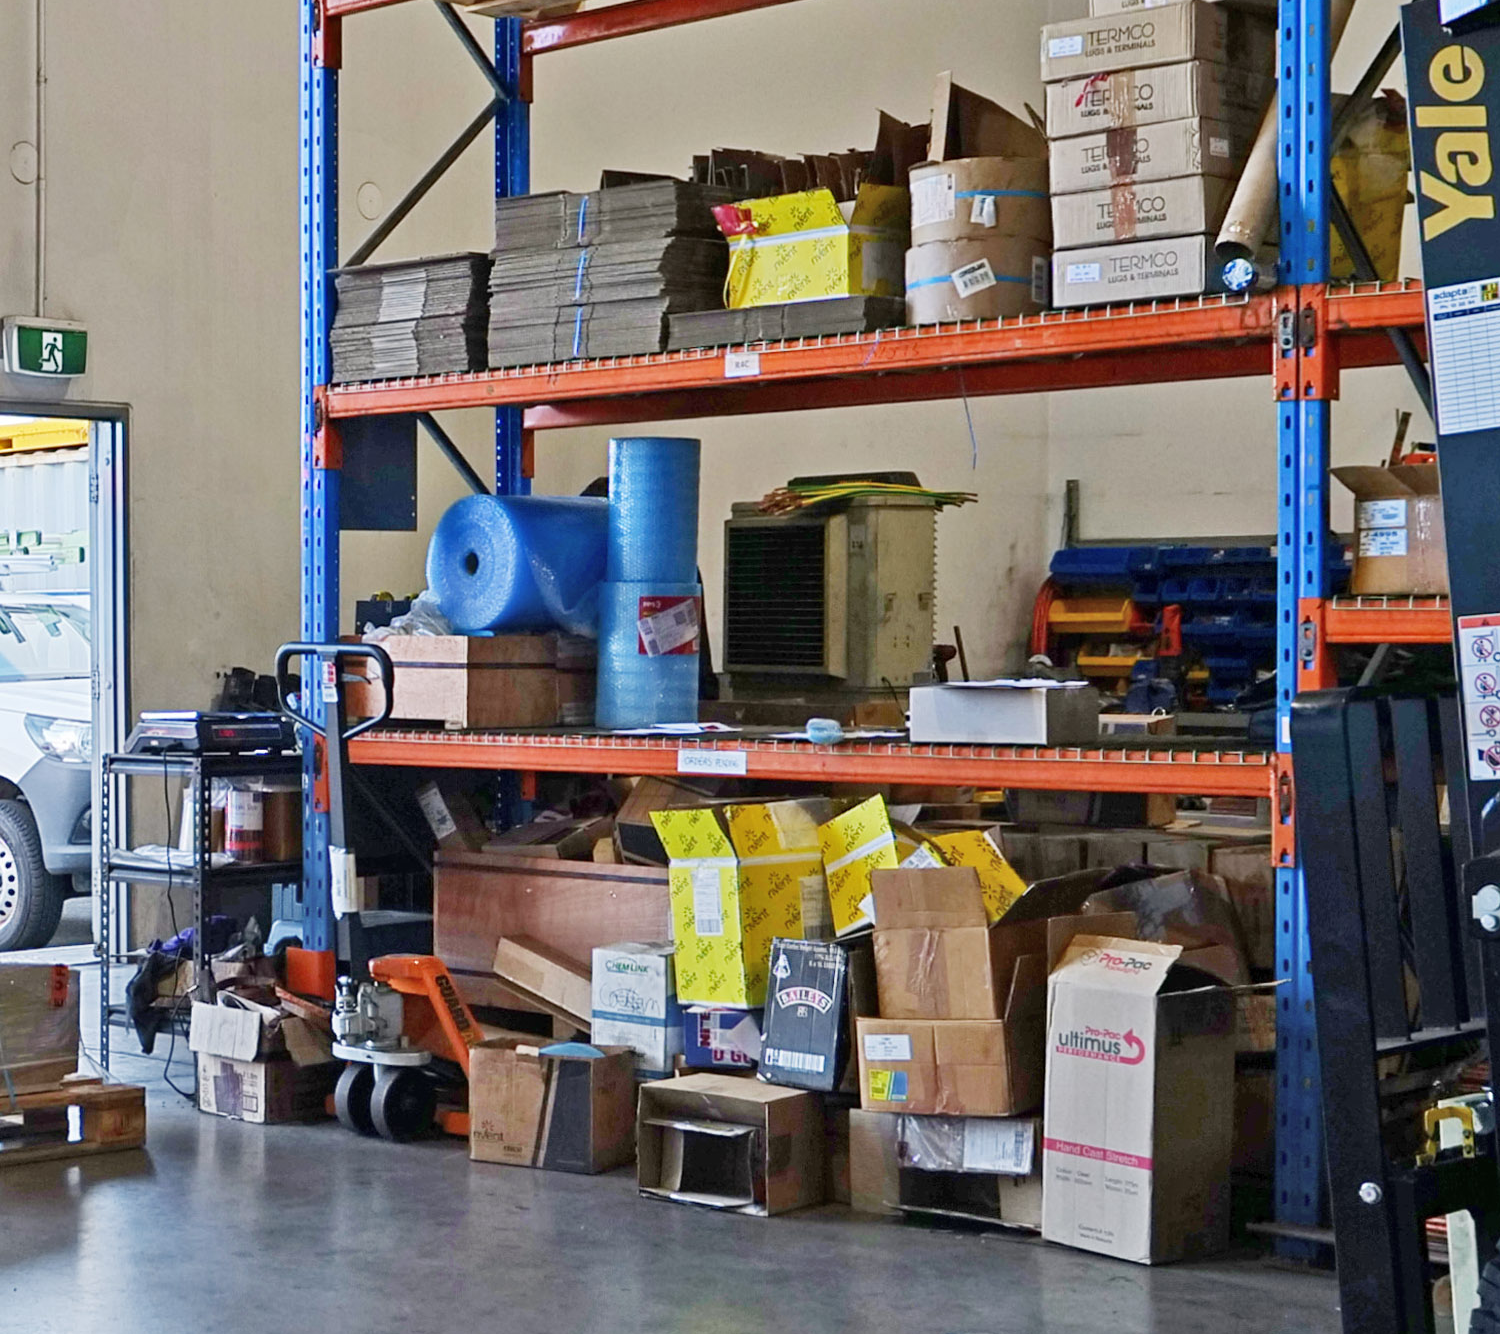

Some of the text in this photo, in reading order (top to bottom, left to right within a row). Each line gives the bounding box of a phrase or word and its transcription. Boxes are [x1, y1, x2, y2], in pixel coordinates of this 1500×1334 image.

[1087, 22, 1155, 47] TERMCO
[1085, 47, 1105, 58] LUGS
[1114, 39, 1156, 54] TERMINALS
[1415, 44, 1495, 242] Yale
[1109, 251, 1178, 273] TERMCO
[1137, 267, 1179, 281] TERMINALS
[780, 989, 828, 1009] BAILEYS
[1058, 1031, 1121, 1055] ultimus
[1055, 1141, 1139, 1167] Hand Cast Stretch
